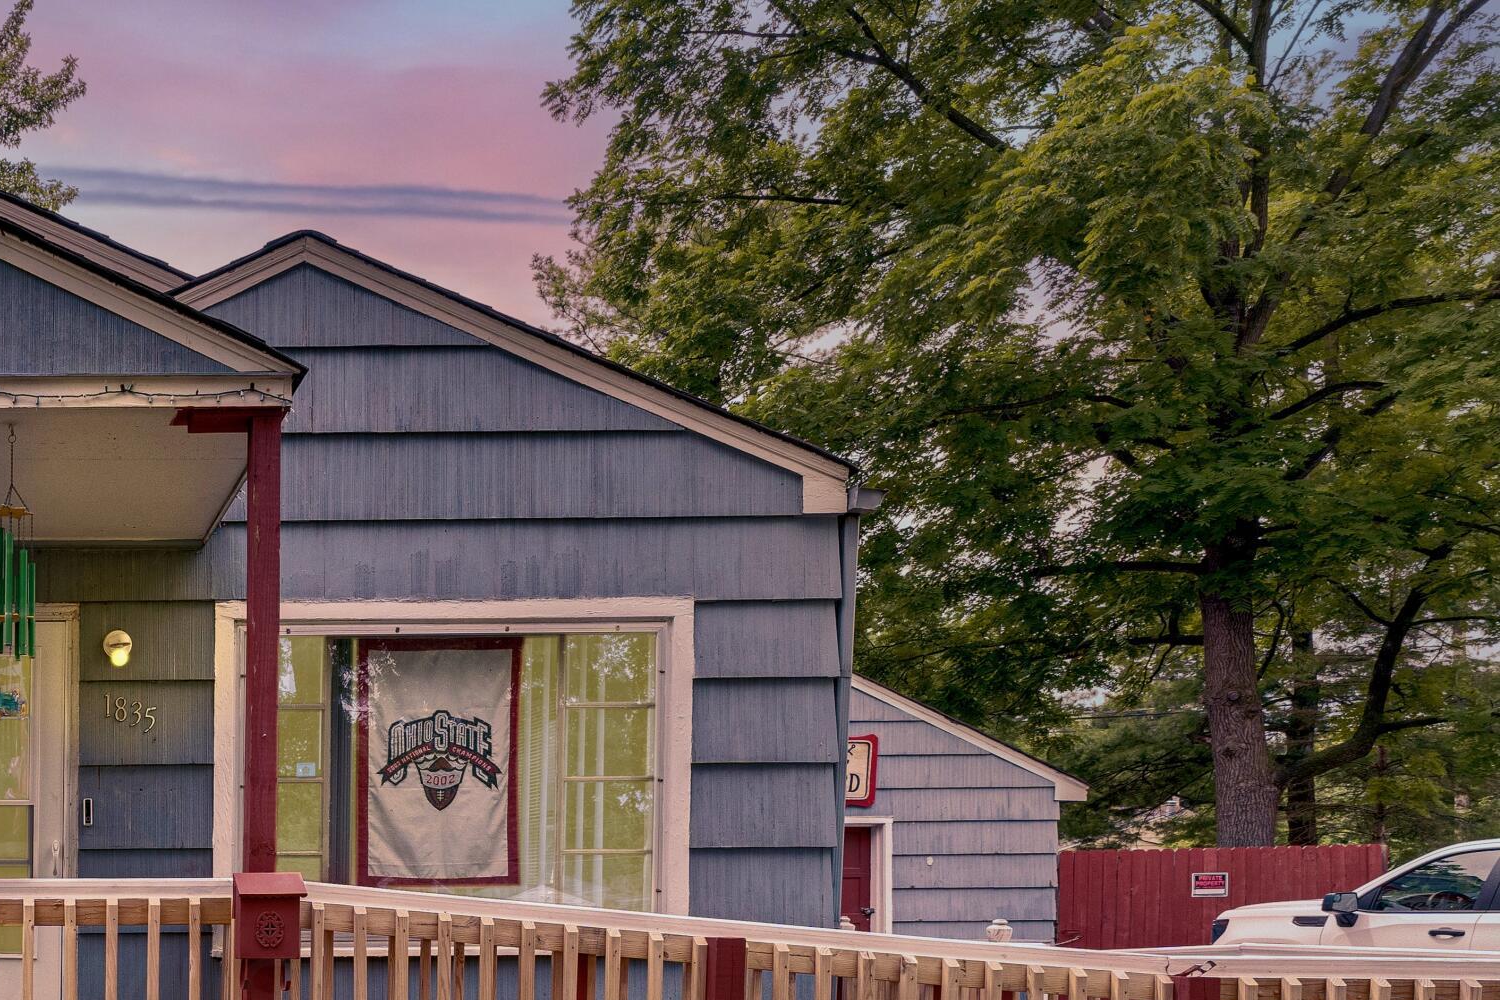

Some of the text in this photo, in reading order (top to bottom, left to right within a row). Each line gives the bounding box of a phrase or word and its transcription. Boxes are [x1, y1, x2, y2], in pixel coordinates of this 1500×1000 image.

[104, 692, 157, 734] 1835
[389, 712, 493, 785] OHIO STATE
[401, 745, 432, 766] NATIONAL
[451, 746, 492, 772] CHAMPIONS
[425, 773, 456, 787] 2002
